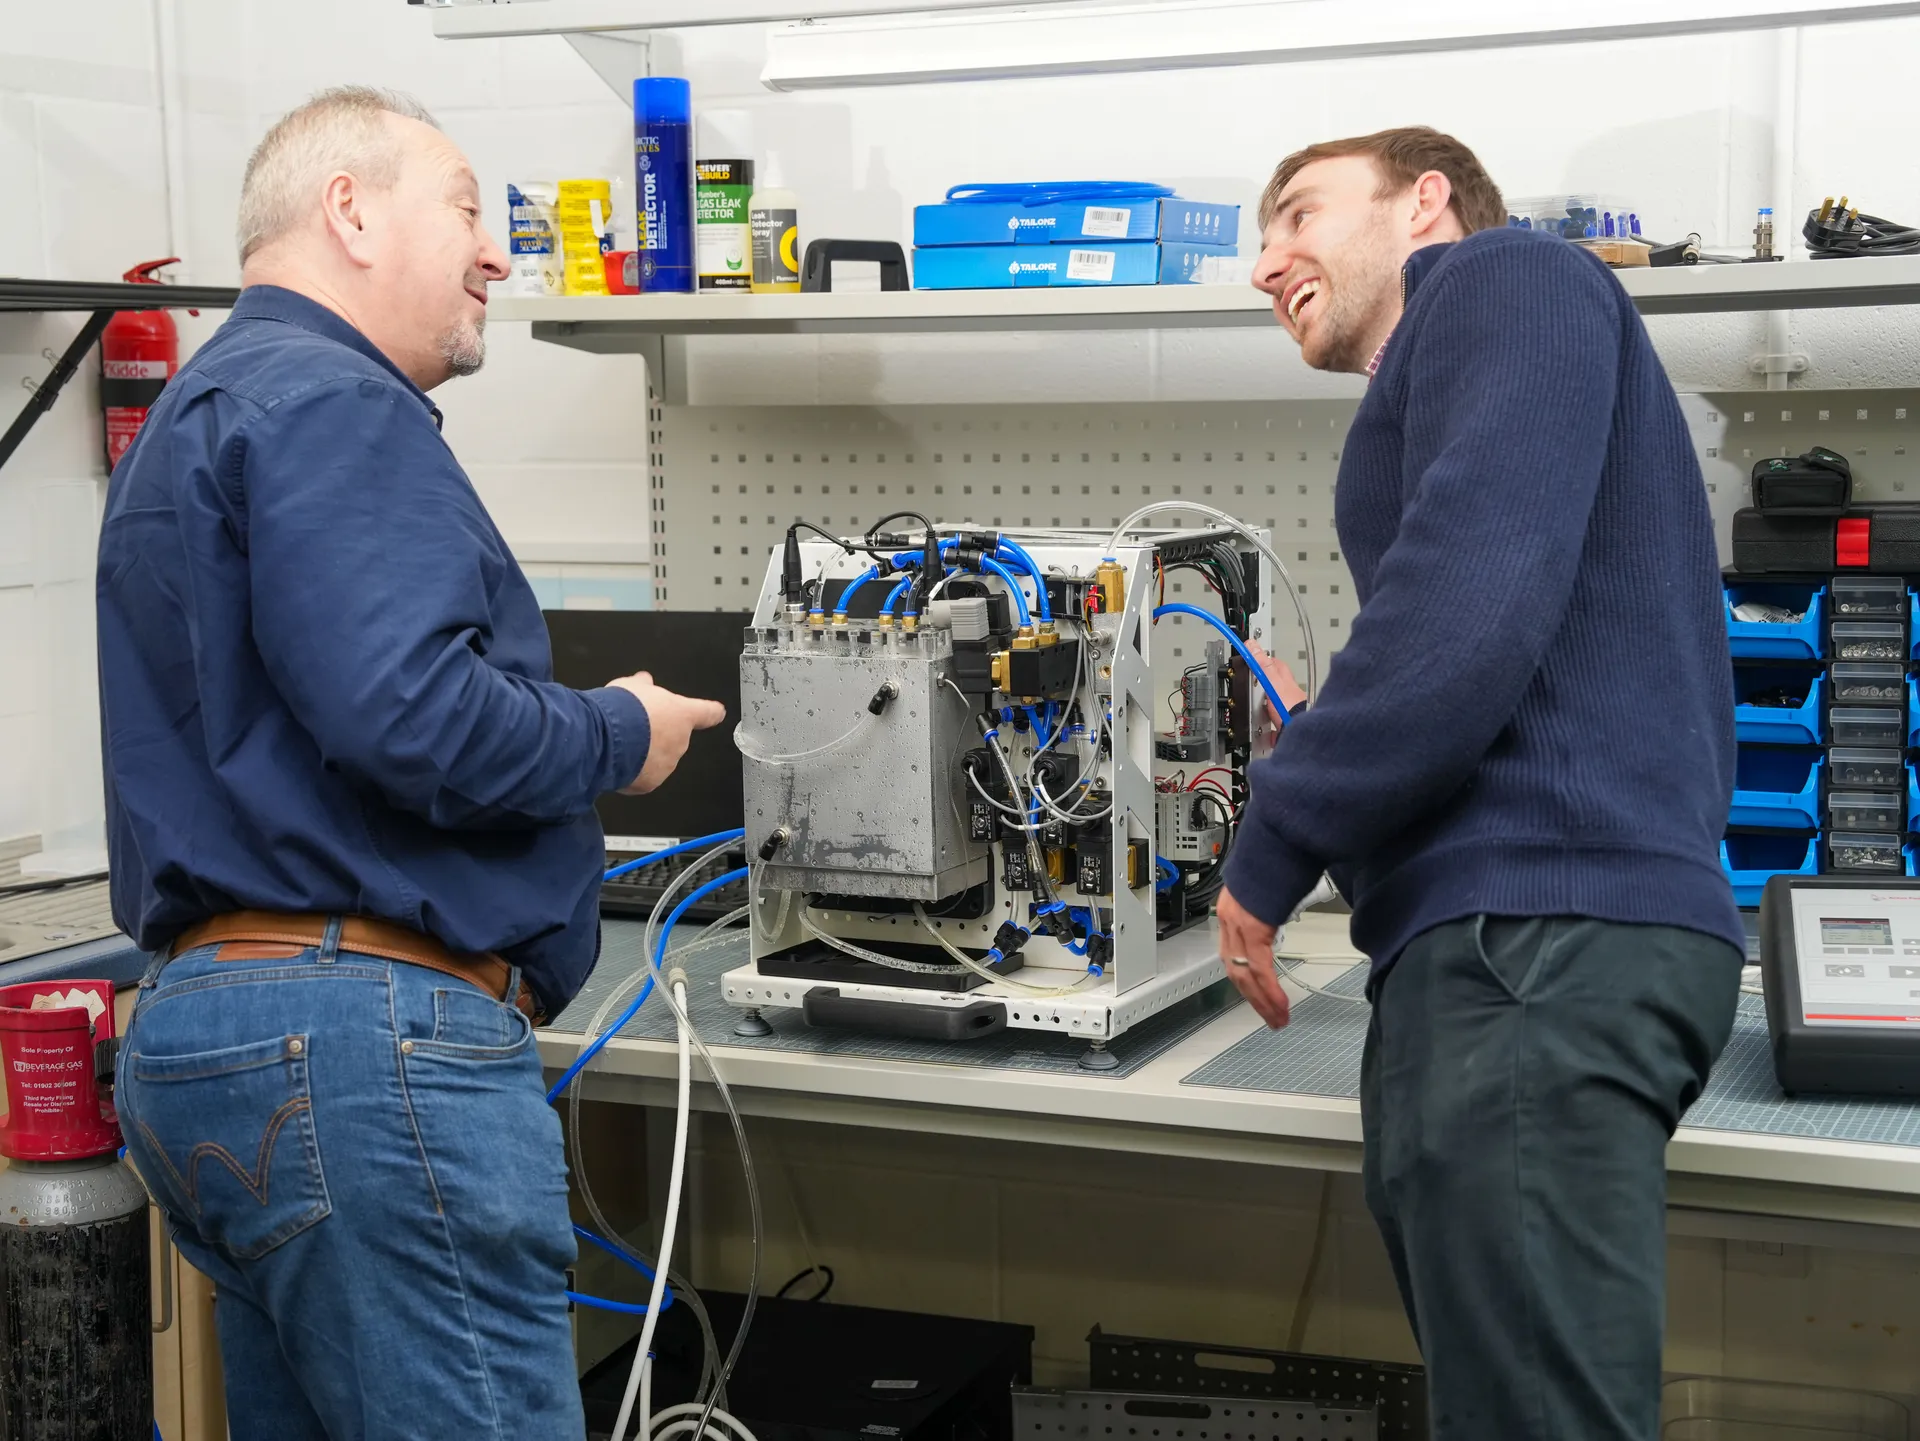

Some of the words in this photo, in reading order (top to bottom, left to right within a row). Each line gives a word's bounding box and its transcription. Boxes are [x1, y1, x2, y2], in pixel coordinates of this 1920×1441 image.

[716, 198, 741, 208] LEAK
[644, 173, 658, 250] DETECTOR
[697, 208, 734, 219] ETECTOR
[1020, 217, 1056, 227] TAILONZ
[638, 210, 647, 250] LEAK
[1020, 262, 1057, 271] TAILONZ
[109, 363, 149, 378] Kidde
[25, 1062, 65, 1070] BEVERAGE
[66, 1060, 83, 1069] GAS
